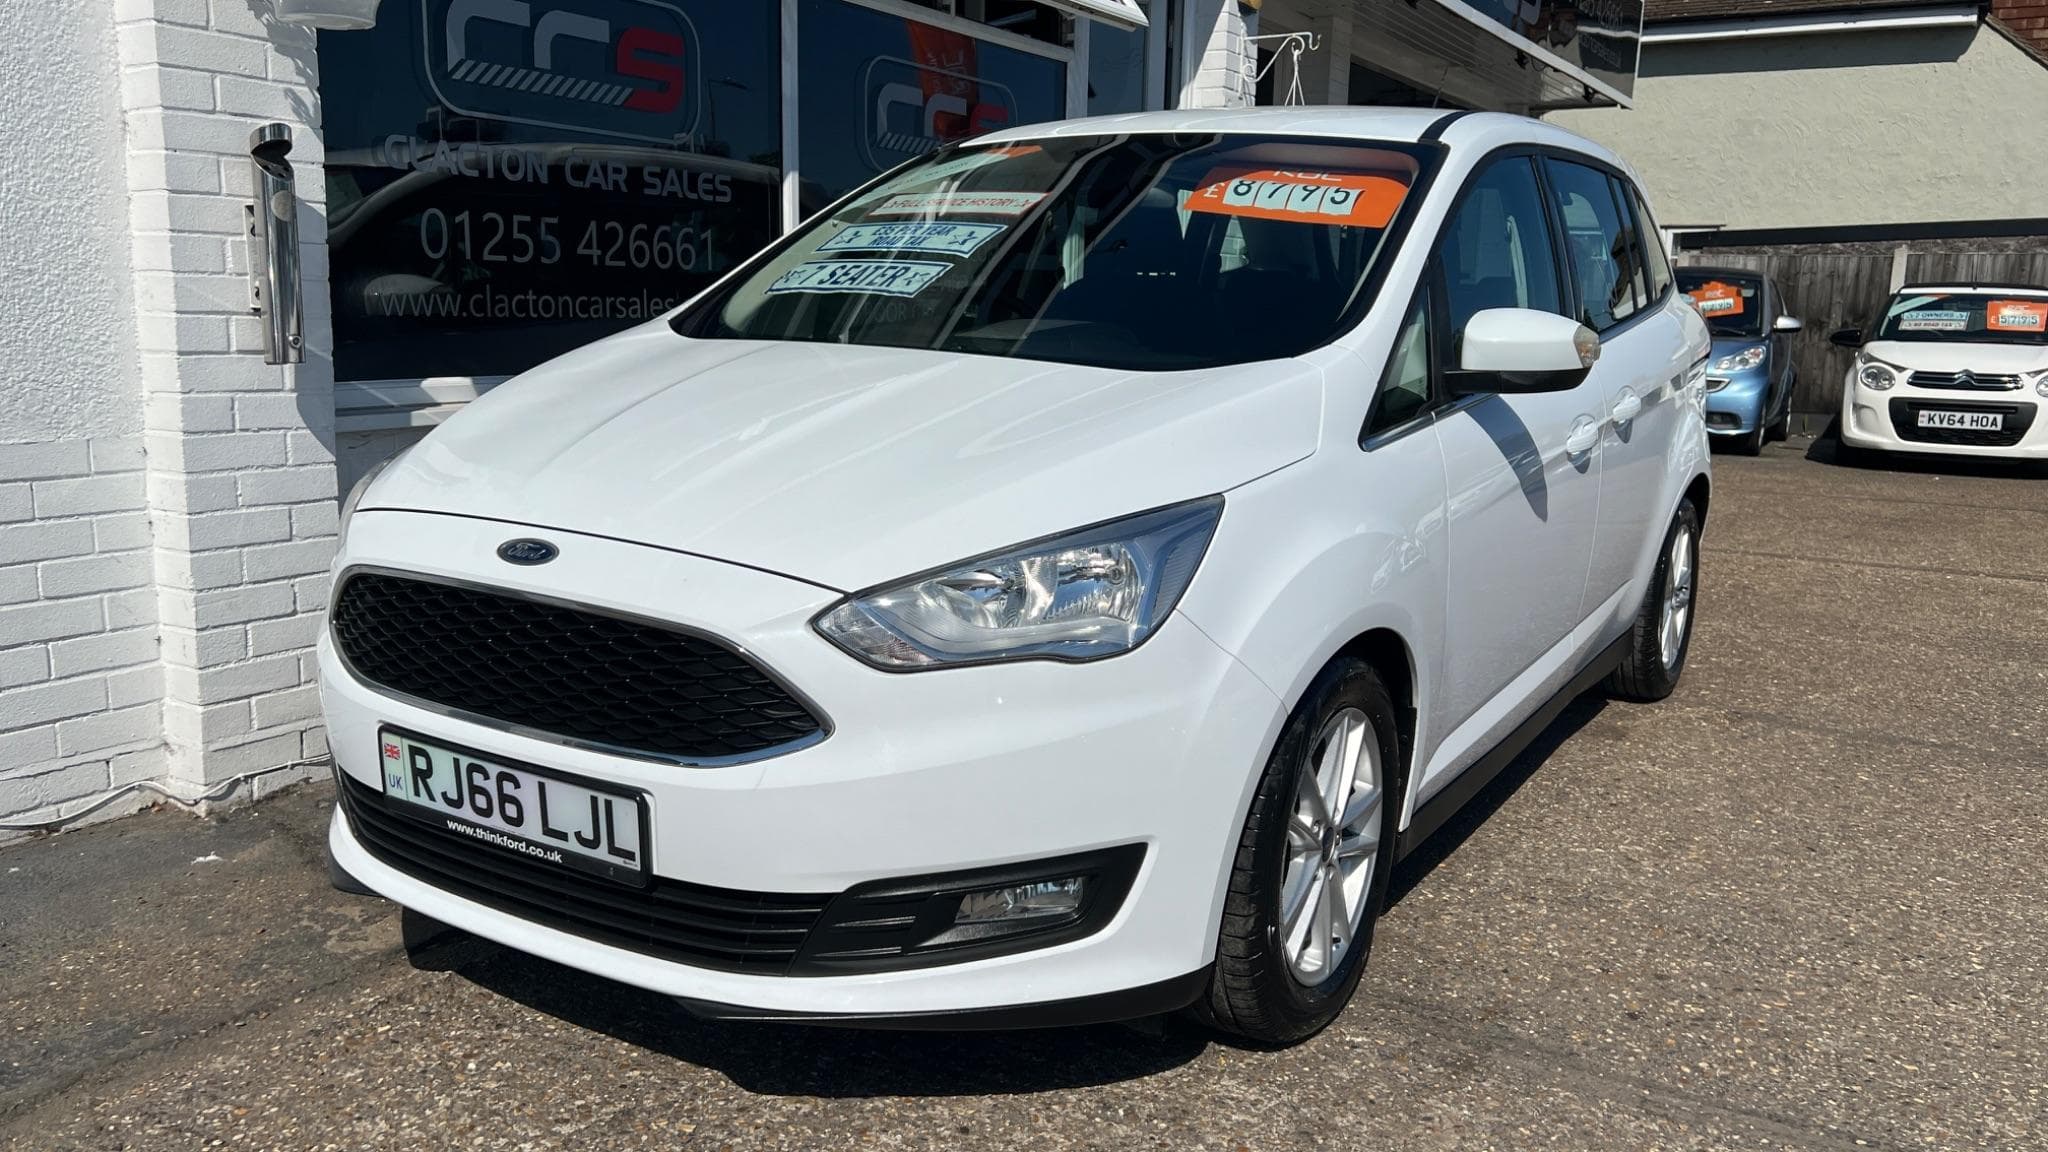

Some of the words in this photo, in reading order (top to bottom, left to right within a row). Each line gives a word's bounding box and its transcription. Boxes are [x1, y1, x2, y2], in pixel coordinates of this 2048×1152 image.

[384, 134, 549, 185] CLACTON
[564, 158, 628, 193] CAR
[643, 167, 733, 203] SALES
[420, 207, 561, 264] 01255
[576, 221, 715, 272] 426661
[799, 264, 827, 285] 7
[817, 264, 911, 288] SEATER
[1926, 412, 1966, 427] KV64
[1969, 414, 1999, 429] HOA
[507, 543, 547, 560] Ford
[388, 773, 403, 790] UK
[407, 744, 526, 828] RJ66
[537, 780, 637, 862] LJL
[446, 818, 563, 864] www.thinkford.co.uk
